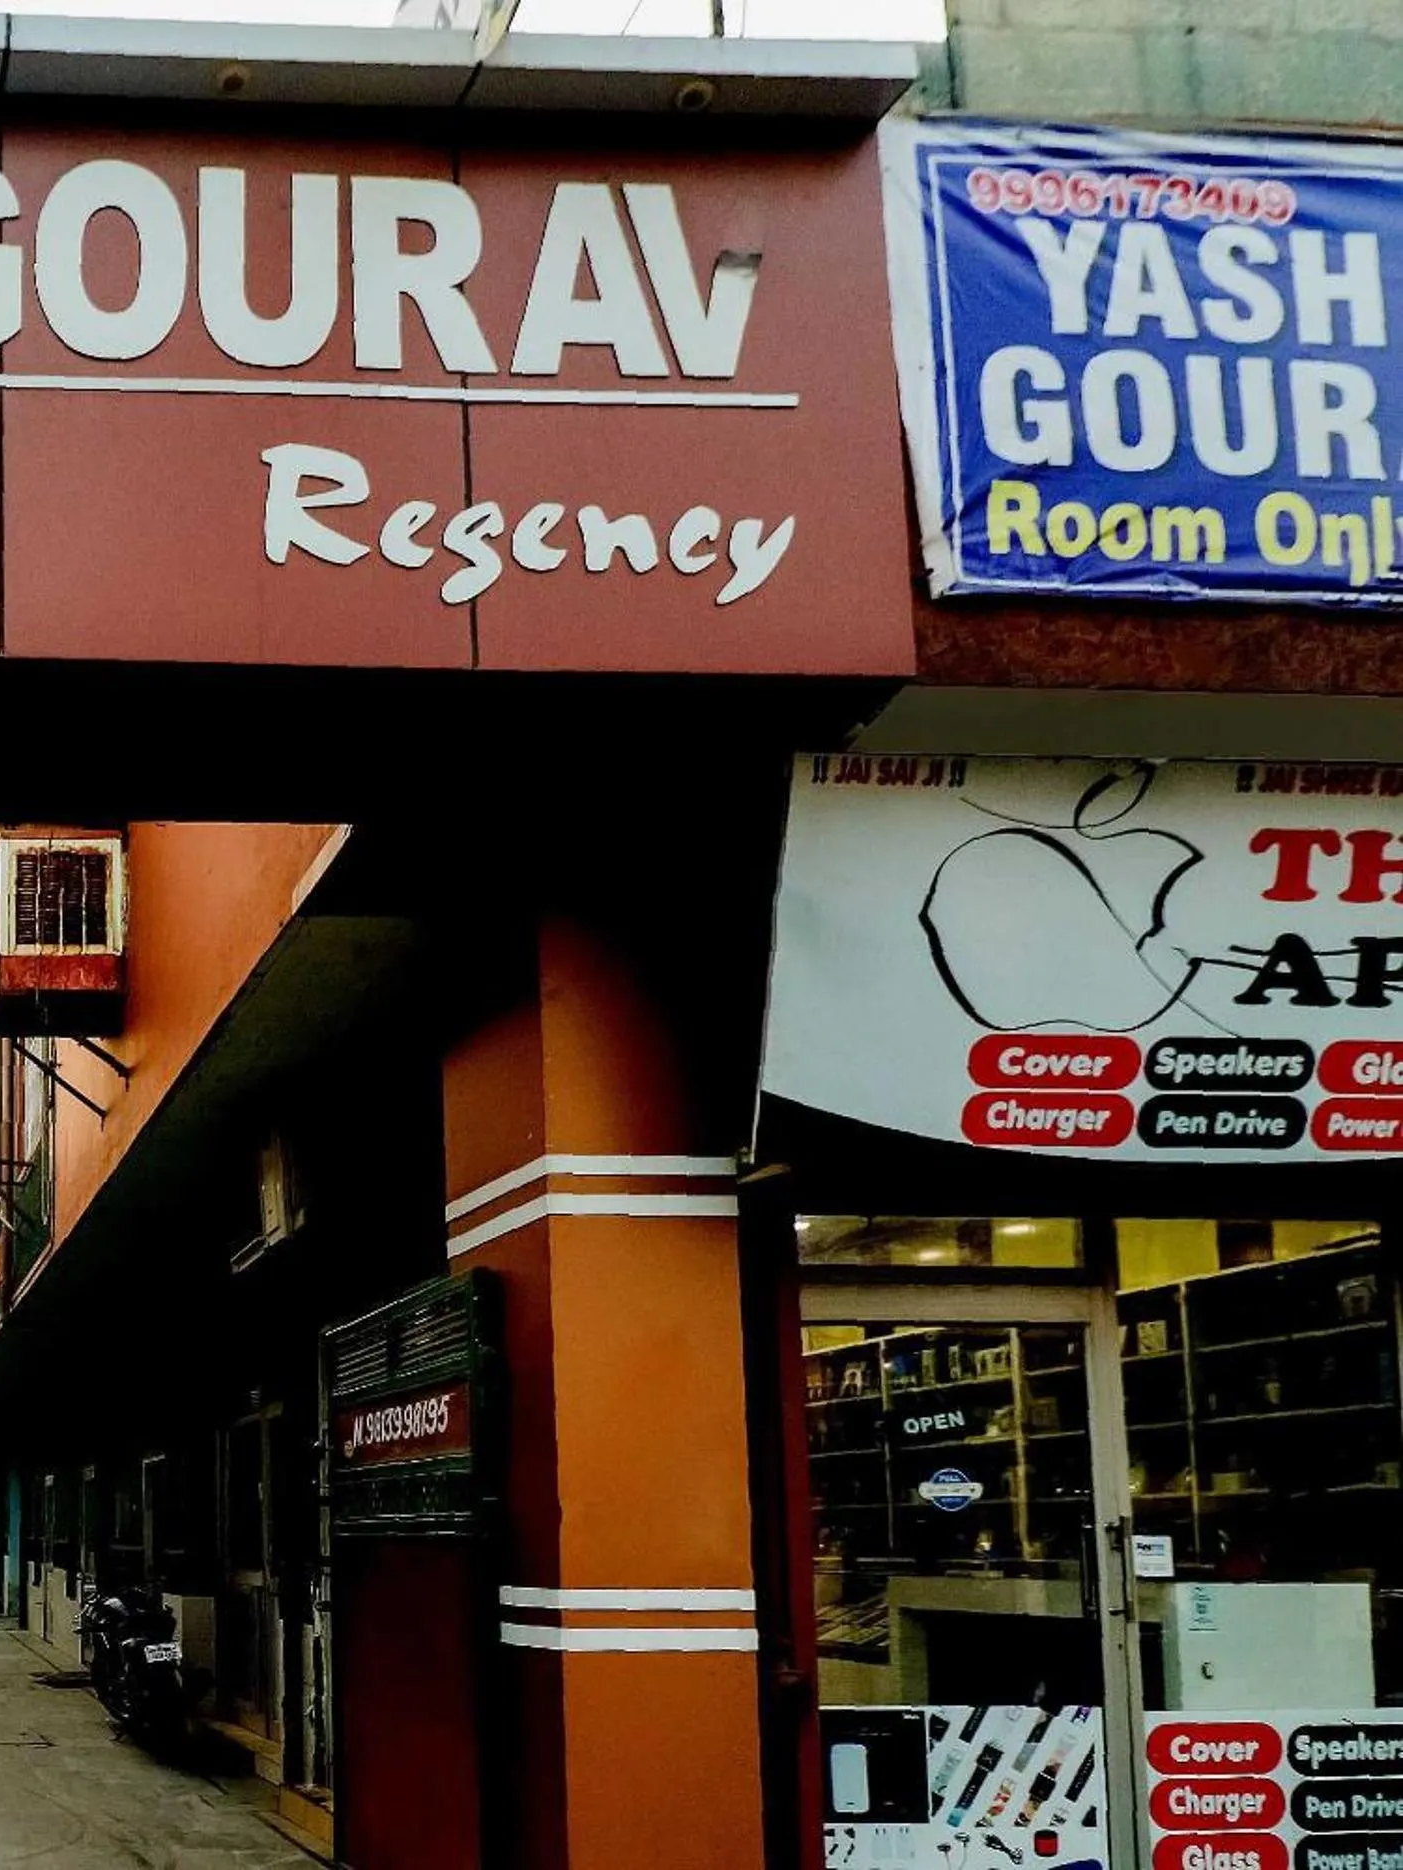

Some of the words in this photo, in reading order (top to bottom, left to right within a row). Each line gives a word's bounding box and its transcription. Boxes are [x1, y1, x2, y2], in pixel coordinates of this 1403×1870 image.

[1014, 217, 1388, 347] YASH
[979, 344, 1403, 481] GOUR
[261, 441, 797, 605] Regency
[986, 479, 1226, 565] Room
[1254, 490, 1403, 587] Onl
[998, 1046, 1112, 1077] Cover
[1154, 1046, 1304, 1083] Speakers
[986, 1101, 1111, 1141] Charger
[1155, 1110, 1207, 1135] Pen
[1214, 1109, 1287, 1136] Drive
[1327, 1111, 1400, 1139] Power
[903, 1410, 966, 1434] OPEN
[1169, 1735, 1259, 1763] Cover
[1168, 1785, 1266, 1822] Charger
[1305, 1795, 1346, 1819] Pen
[1181, 1843, 1261, 1870] Glass
[1306, 1848, 1364, 1870] Power
